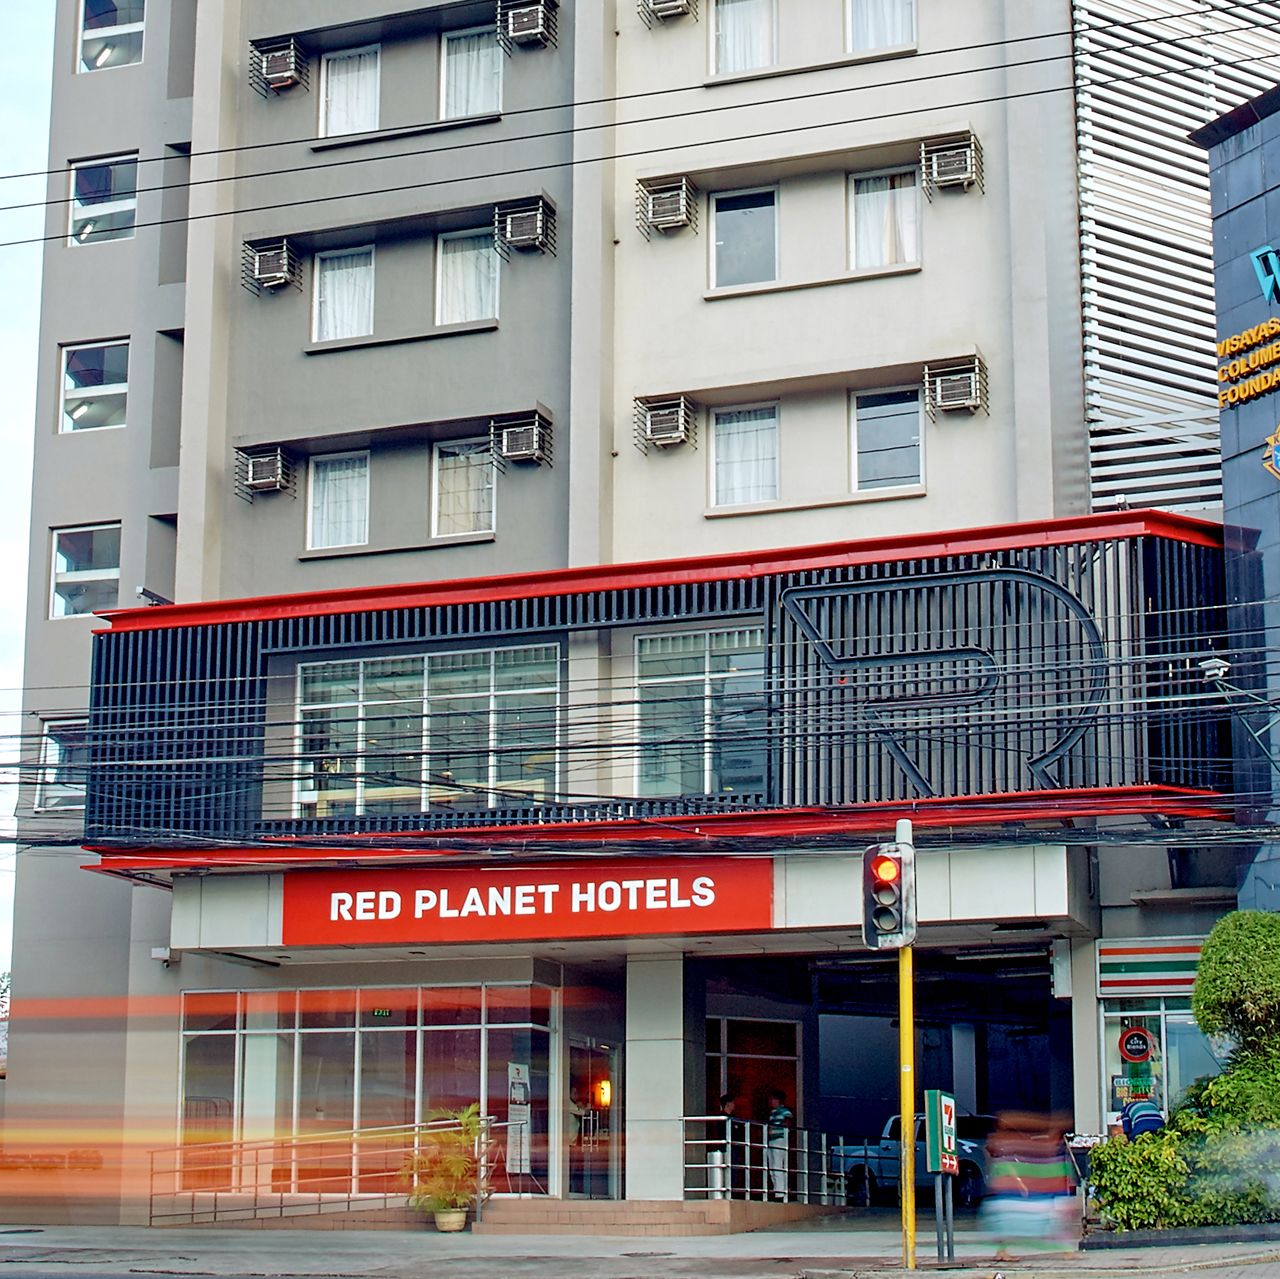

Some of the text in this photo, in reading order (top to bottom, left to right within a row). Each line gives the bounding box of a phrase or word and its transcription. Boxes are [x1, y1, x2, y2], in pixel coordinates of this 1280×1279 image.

[1216, 317, 1280, 357] VISAYAS
[330, 876, 716, 921] RED PLANET HOTELS
